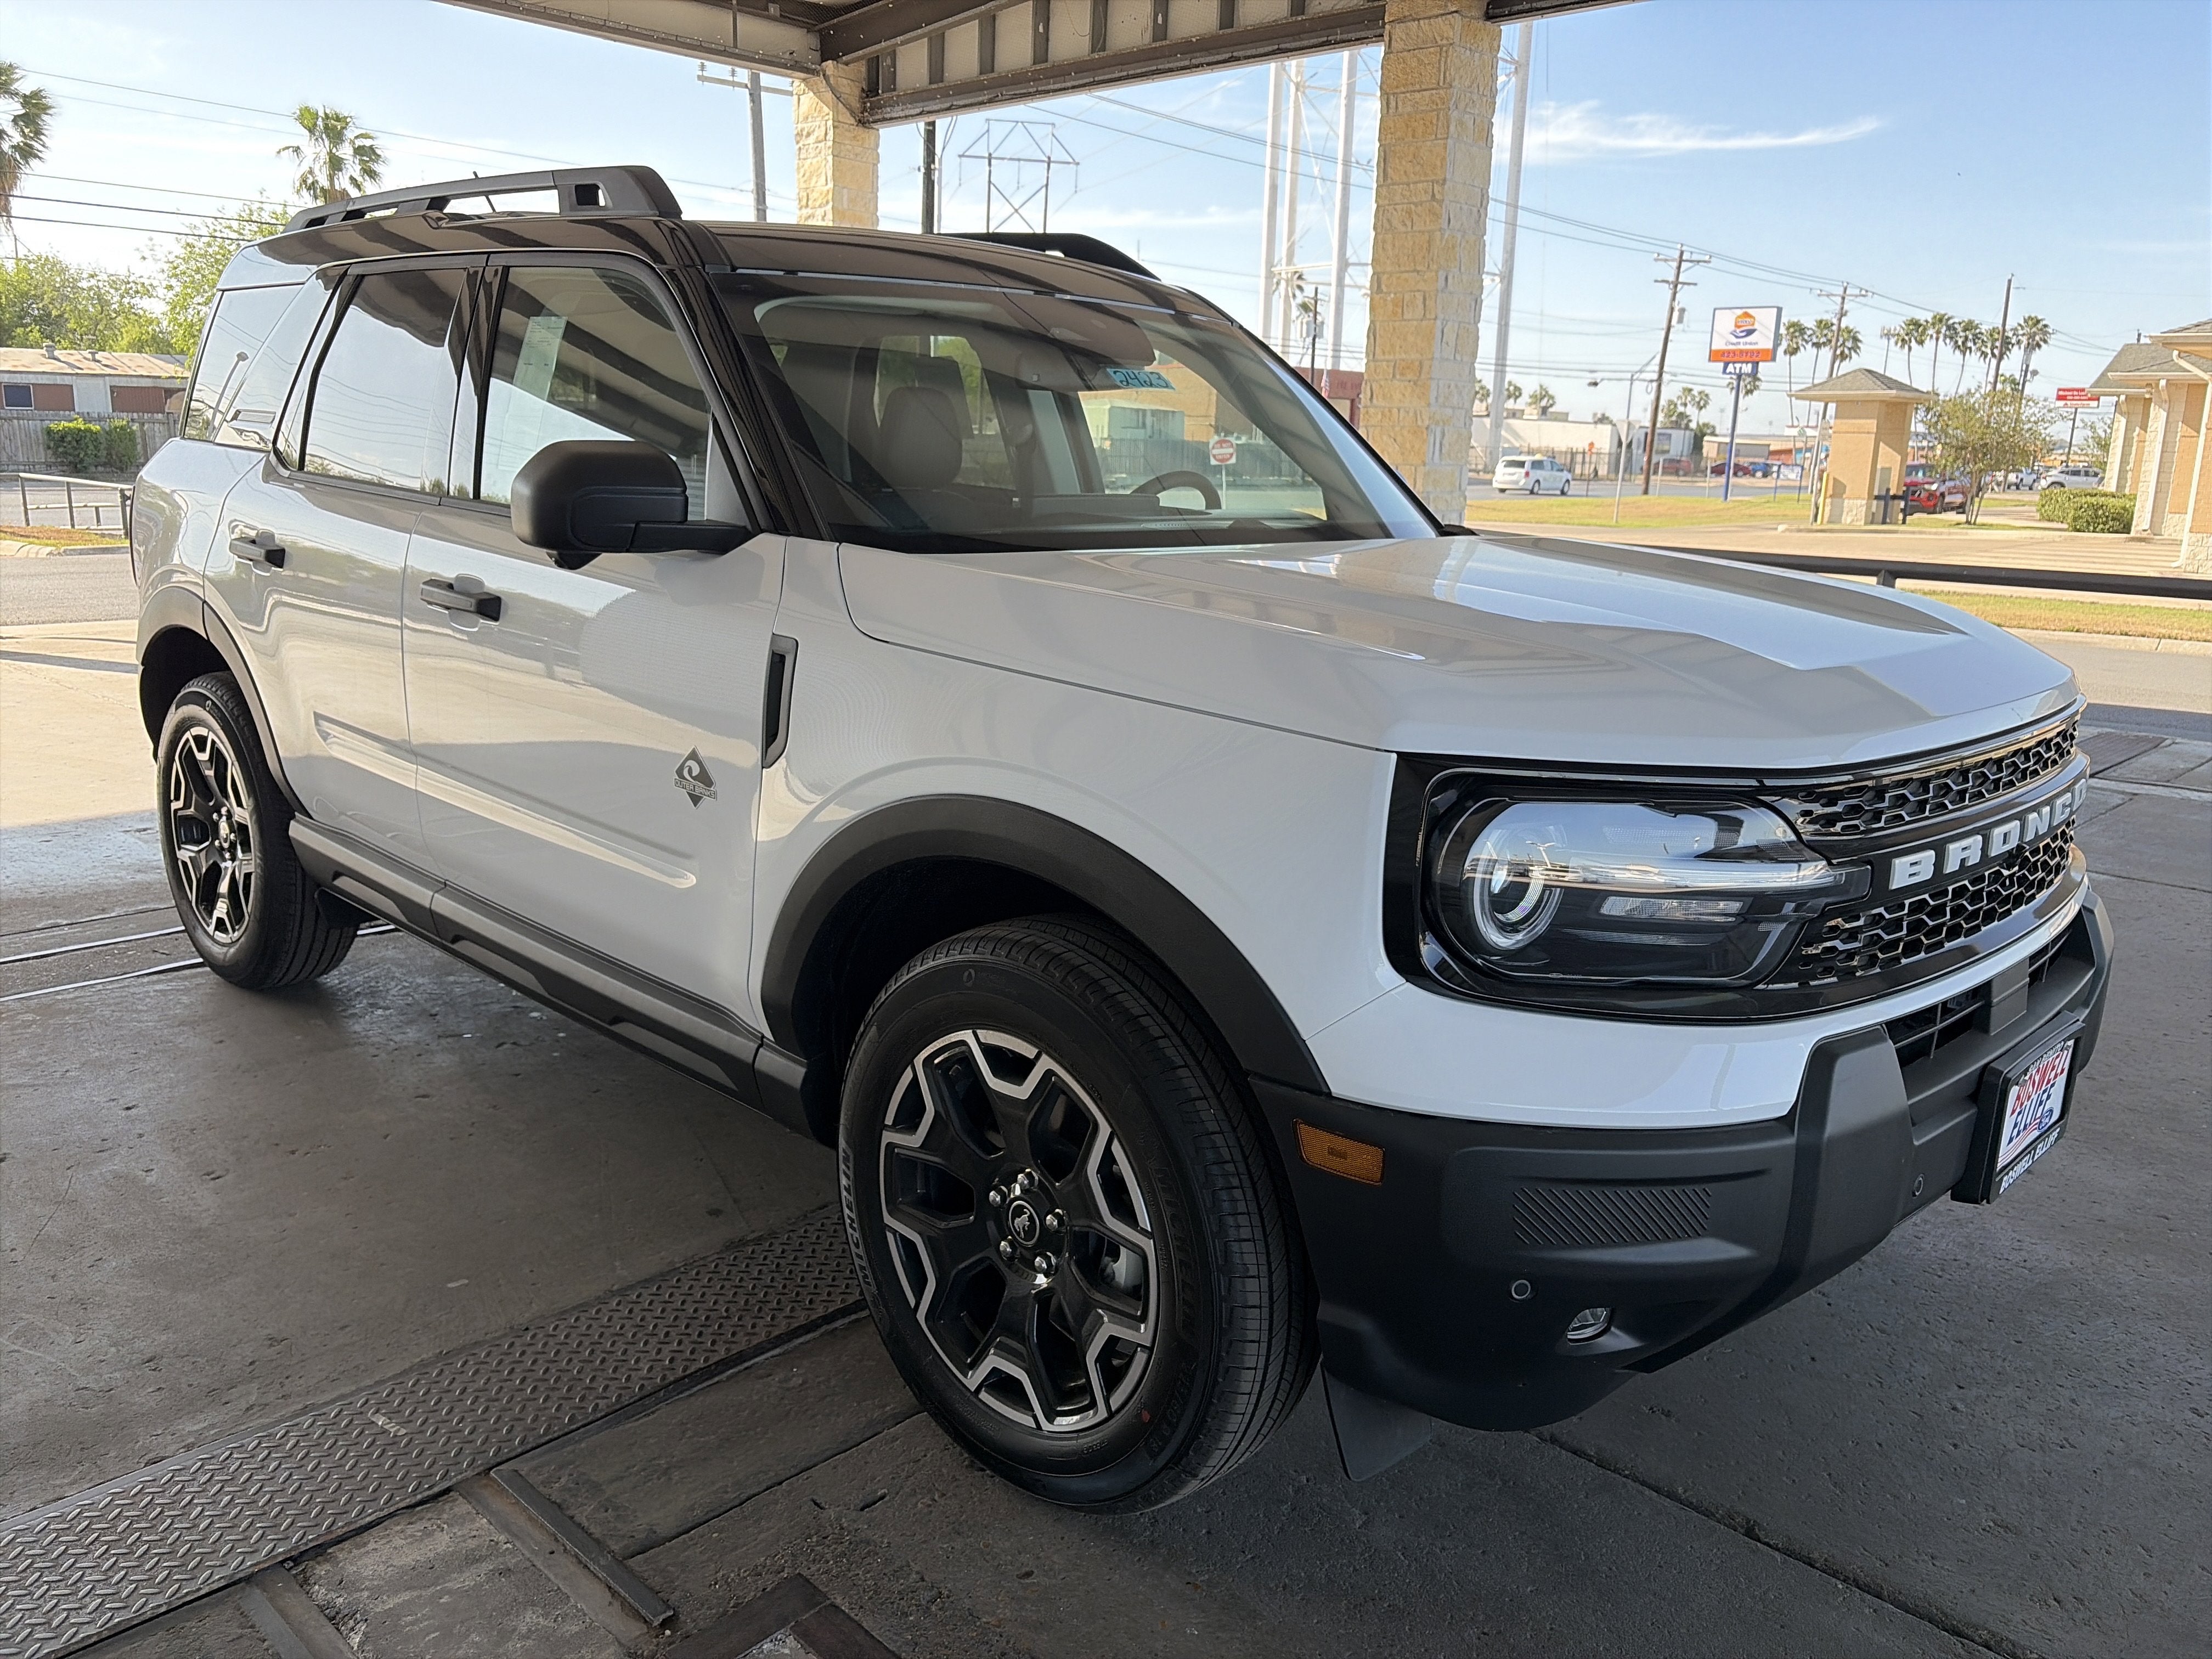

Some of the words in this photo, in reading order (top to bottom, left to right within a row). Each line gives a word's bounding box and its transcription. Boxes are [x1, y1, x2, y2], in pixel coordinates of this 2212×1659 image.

[1113, 370, 1169, 387] 2423
[1725, 363, 1752, 374] ATM
[675, 780, 694, 792] OUTER
[695, 785, 715, 798] BANKS
[1890, 778, 2087, 890] BRONCO
[2009, 1049, 2069, 1118] BOSWELL
[2006, 1080, 2057, 1147] ELLIFF
[2033, 1127, 2061, 1162] ELLIFF
[1999, 1149, 2034, 1194] BOSWELL
[842, 1146, 873, 1288] MICHELIN
